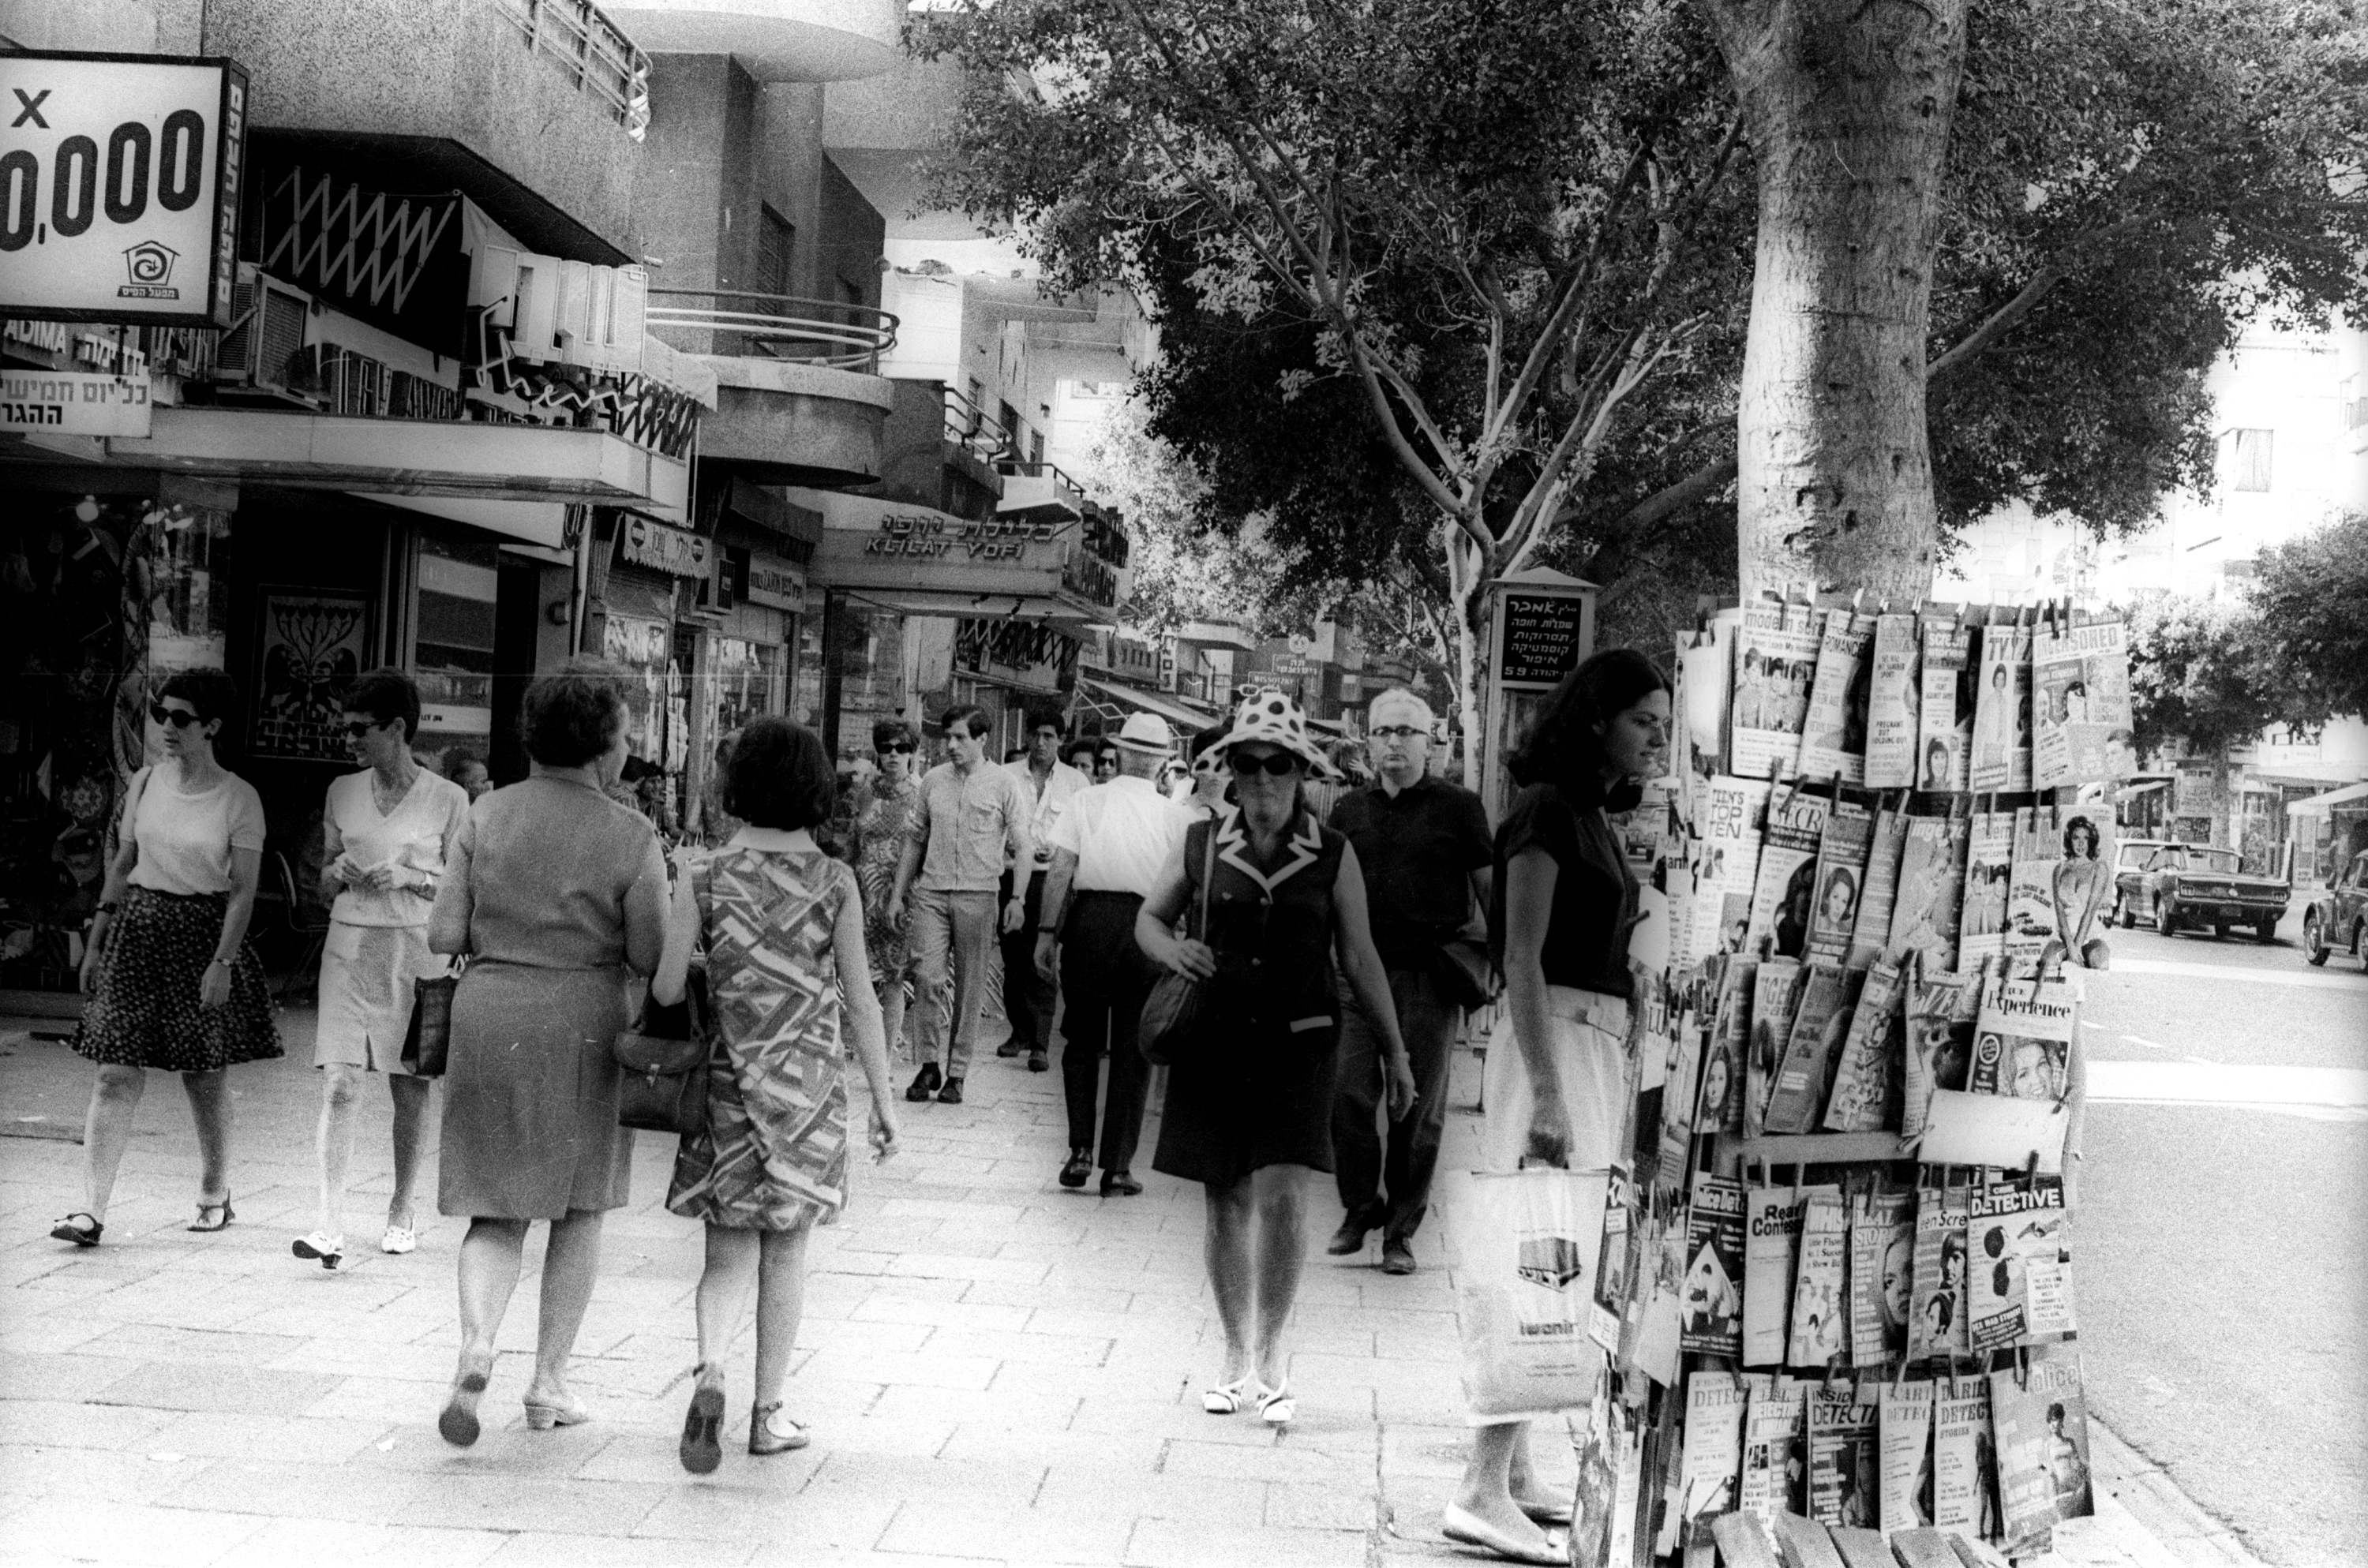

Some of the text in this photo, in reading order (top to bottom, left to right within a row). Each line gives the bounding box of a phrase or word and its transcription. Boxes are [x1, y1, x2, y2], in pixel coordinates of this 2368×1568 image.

[122, 286, 176, 298] מפעל הפיס
[82, 381, 115, 404] יום
[122, 379, 148, 405] כל
[880, 513, 1058, 541] כלילת יופי
[865, 537, 1025, 560] KLILAT YOFI
[1511, 617, 1538, 627] חופה
[1744, 612, 1794, 634] moden
[1513, 631, 1570, 642] תסרוקות
[1511, 642, 1570, 657] קוסמטיקה
[1521, 654, 1559, 665] איפור
[1504, 666, 1527, 677] 59
[1711, 804, 1743, 822] TOP
[1709, 820, 1741, 840] TEN
[1812, 1388, 1854, 1404] INSID
